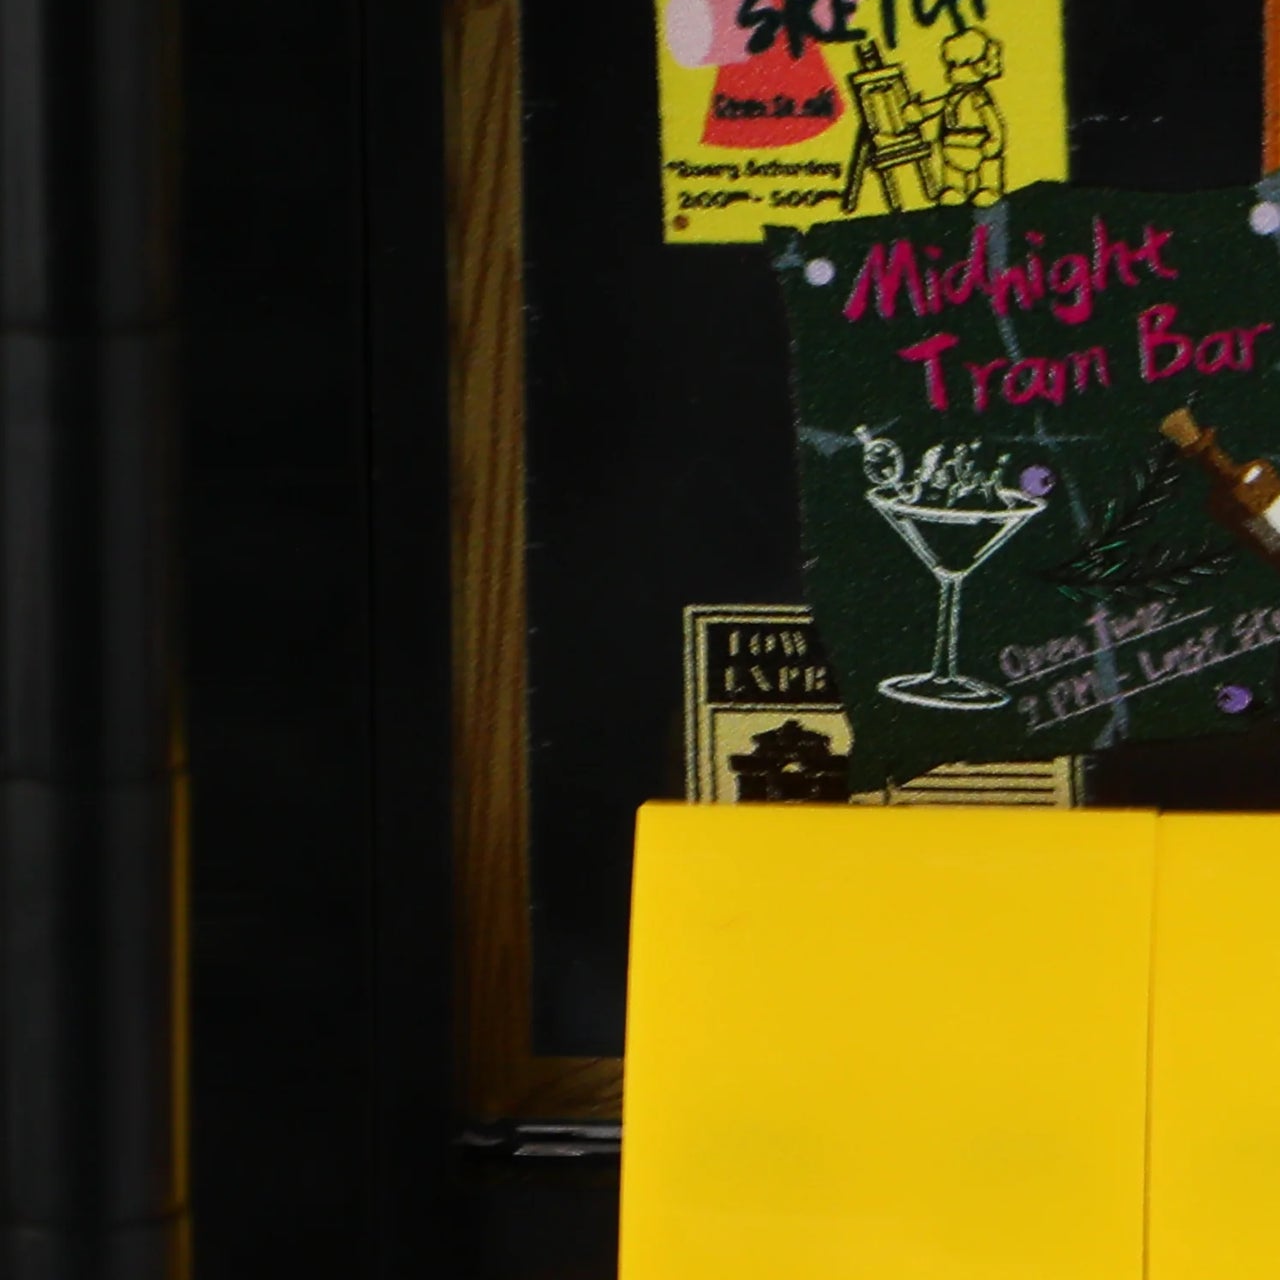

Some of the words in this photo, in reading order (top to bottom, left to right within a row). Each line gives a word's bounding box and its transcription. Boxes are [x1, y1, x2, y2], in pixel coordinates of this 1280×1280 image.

[846, 213, 1179, 325] Midnight
[899, 333, 1110, 413] Tram
[1138, 303, 1272, 384] Bar
